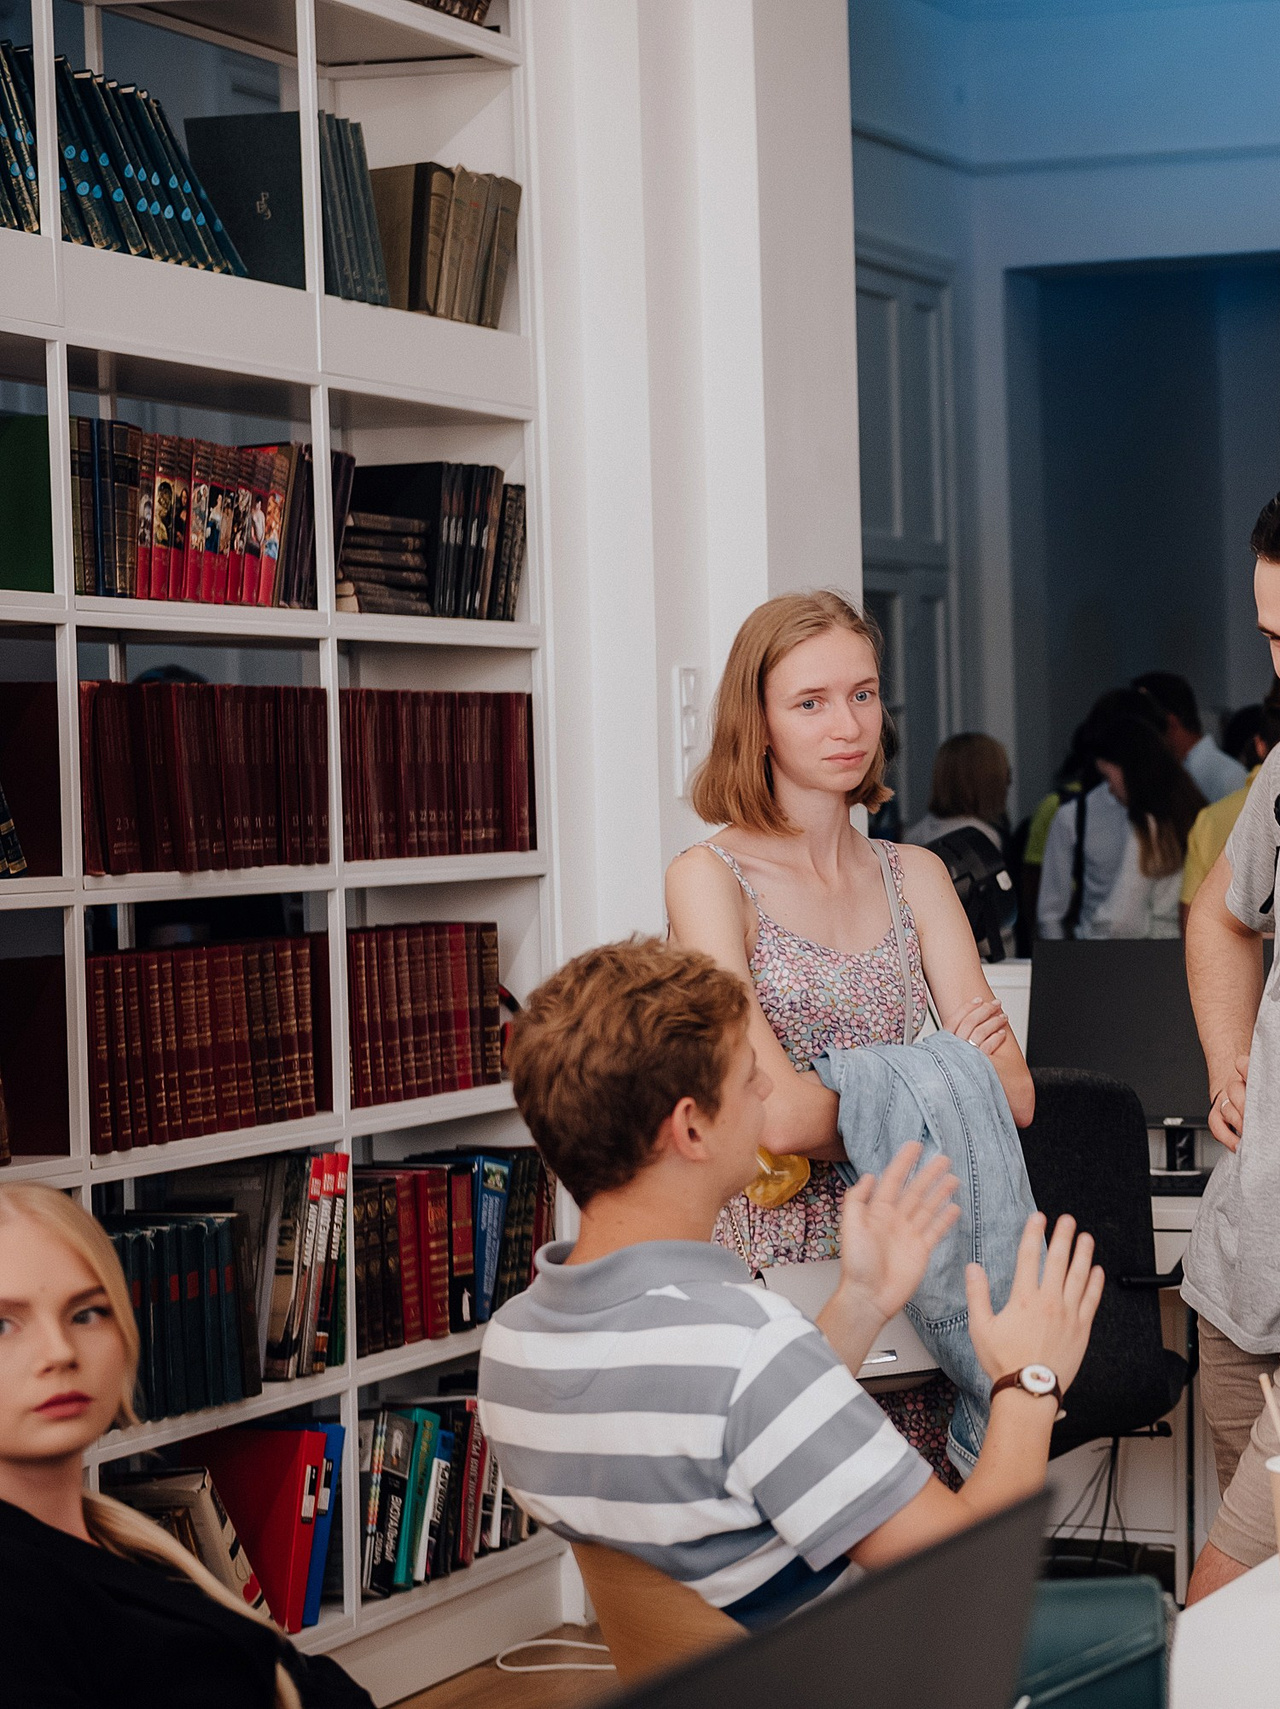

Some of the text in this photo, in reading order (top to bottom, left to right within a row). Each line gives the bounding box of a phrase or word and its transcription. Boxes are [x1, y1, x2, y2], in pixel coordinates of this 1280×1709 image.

[303, 1203, 318, 1267] НАМЕДНИ
[317, 1198, 332, 1262] НАМЕДНИ
[331, 1197, 345, 1260] НАМЕДНИ
[385, 1494, 402, 1563] ВИЗУАЛЬНЫЙ
